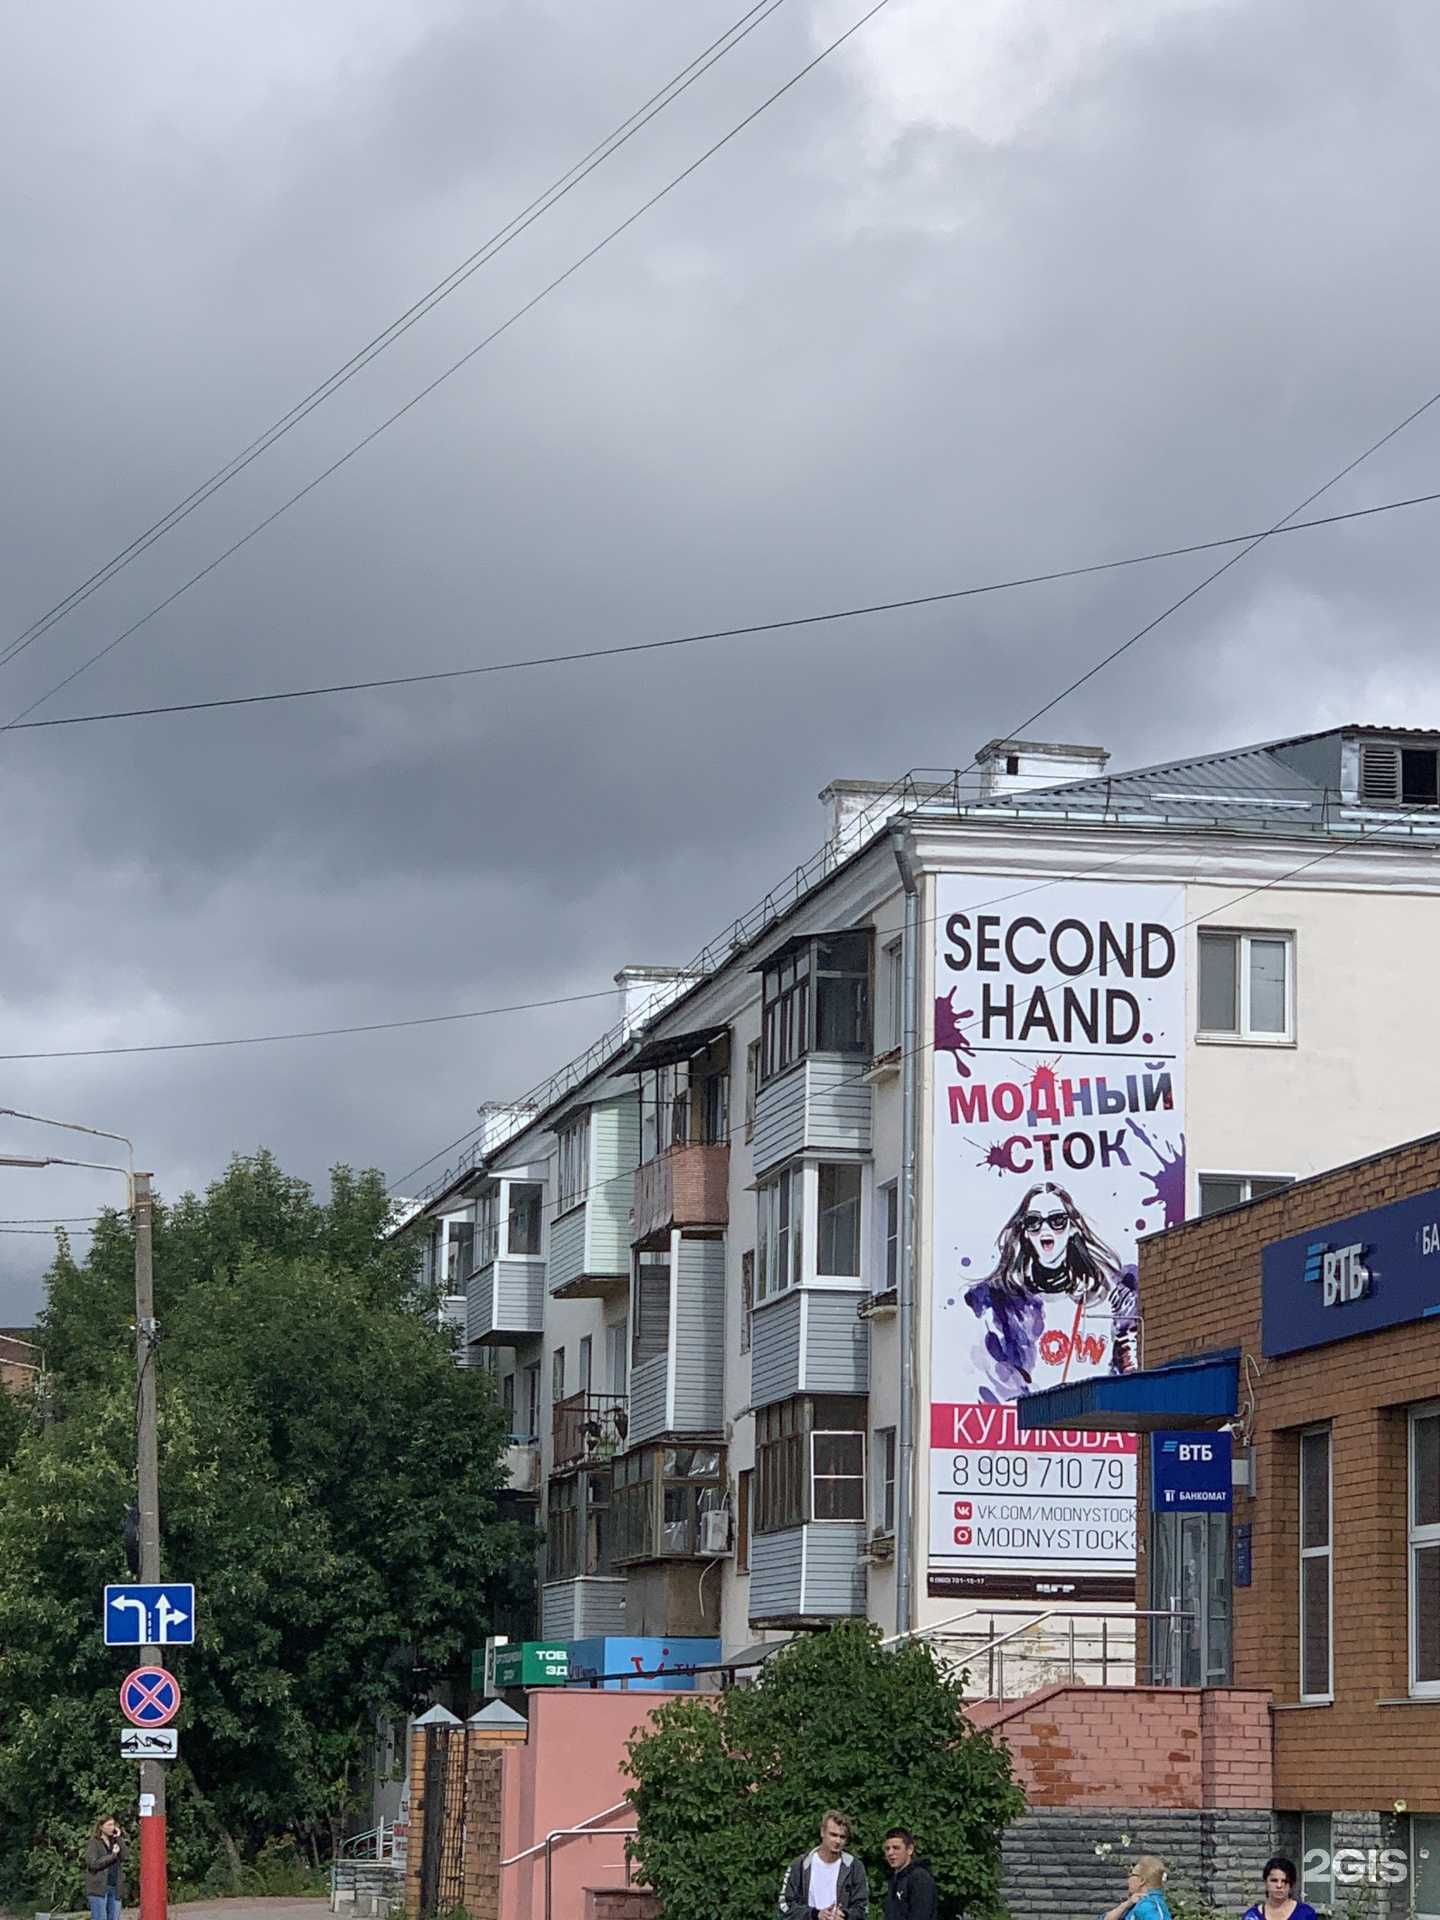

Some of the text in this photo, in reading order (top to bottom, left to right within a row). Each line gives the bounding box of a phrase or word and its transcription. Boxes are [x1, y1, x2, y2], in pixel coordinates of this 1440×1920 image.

[944, 913, 1176, 979] SECOND
[947, 1061, 1175, 1127] МОДНЫЙ
[1003, 1129, 1132, 1174] СТОК
[1323, 1242, 1369, 1307] ВТБ
[953, 1455, 1124, 1490] 8 999 710 79
[1178, 1444, 1213, 1461] ВТБ
[1179, 1491, 1228, 1501] БАНКОМАТ
